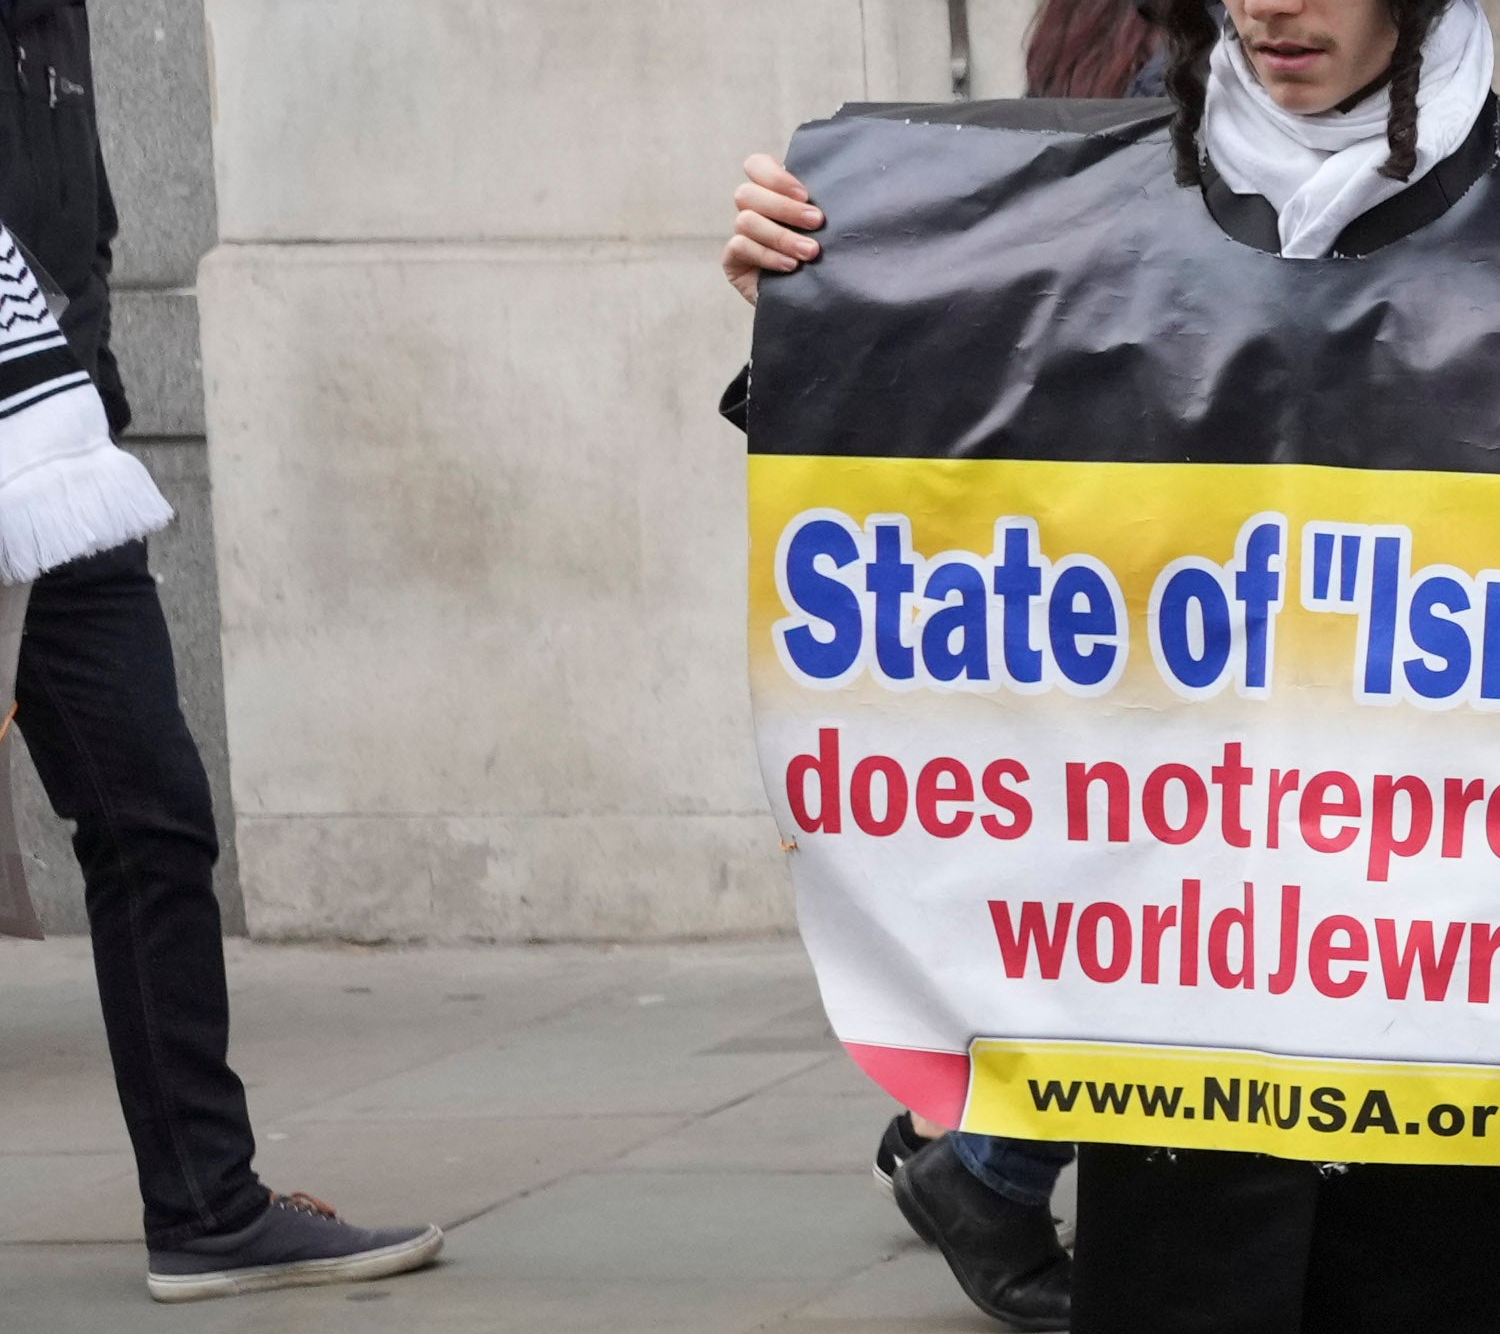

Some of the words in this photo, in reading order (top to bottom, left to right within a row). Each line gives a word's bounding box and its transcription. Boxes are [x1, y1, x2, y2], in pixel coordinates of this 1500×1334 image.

[784, 518, 1119, 686] State
[1159, 523, 1282, 690] of
[786, 727, 1034, 841] does
[1066, 742, 1254, 850] not
[988, 878, 1256, 990] world
